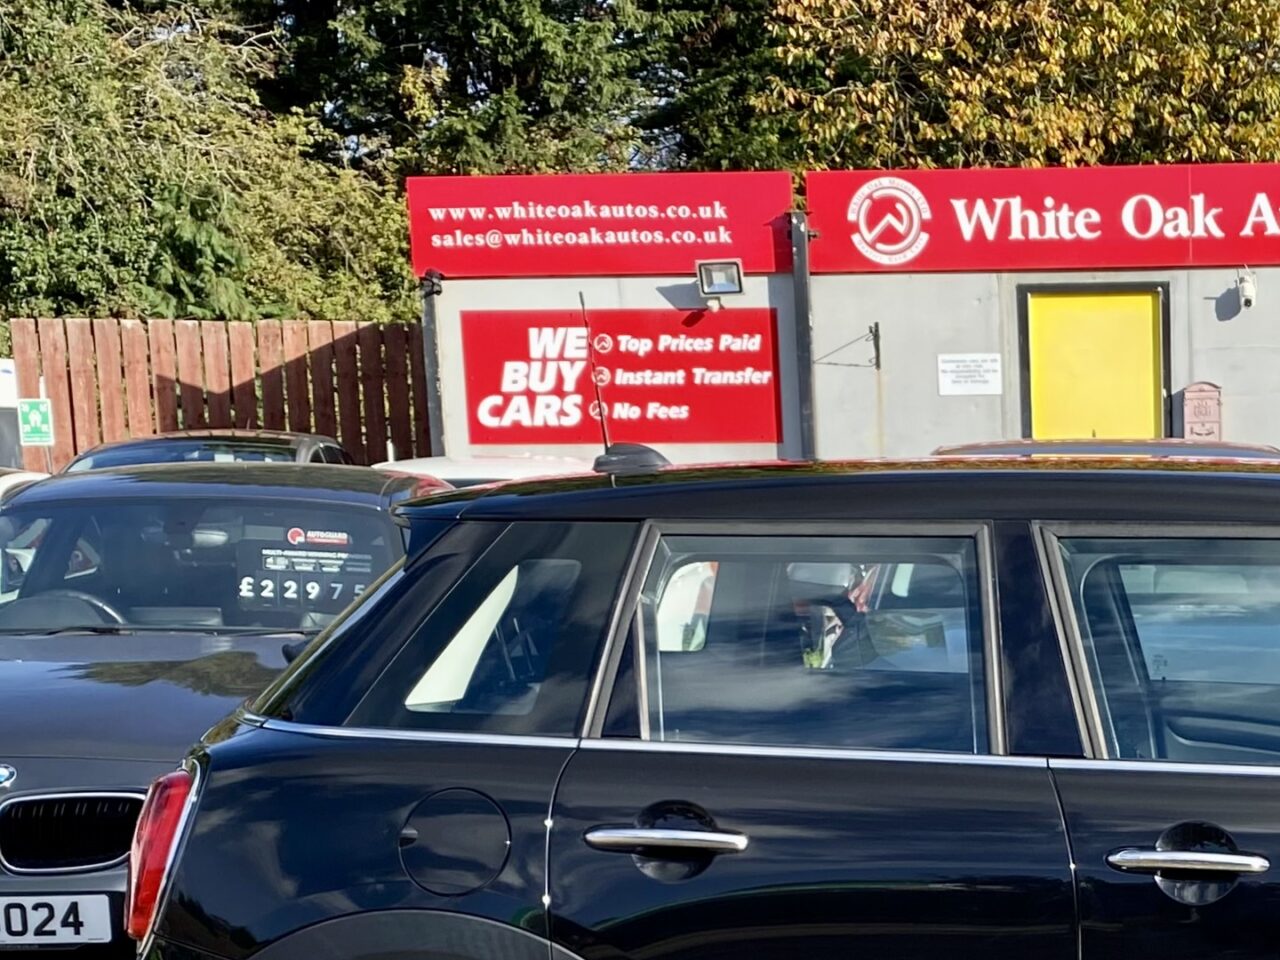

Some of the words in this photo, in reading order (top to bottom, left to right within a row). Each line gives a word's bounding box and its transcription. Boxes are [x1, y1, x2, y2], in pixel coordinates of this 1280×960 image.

[428, 201, 728, 222] www.whiteoakautos.co.uk
[949, 195, 1102, 241] White
[1121, 192, 1225, 239] Oak
[431, 227, 733, 248] sales@whiteoakautos.co.uk
[528, 326, 589, 360] WE
[616, 334, 653, 357] Top
[657, 334, 714, 352] Prices
[718, 333, 762, 352] Paid
[501, 360, 588, 394] BUY
[614, 368, 686, 386] Instant
[691, 366, 773, 386] Transfer
[476, 394, 583, 428] CARS
[612, 401, 642, 420] No
[646, 401, 690, 420] Fees
[4, 901, 84, 937] 024
